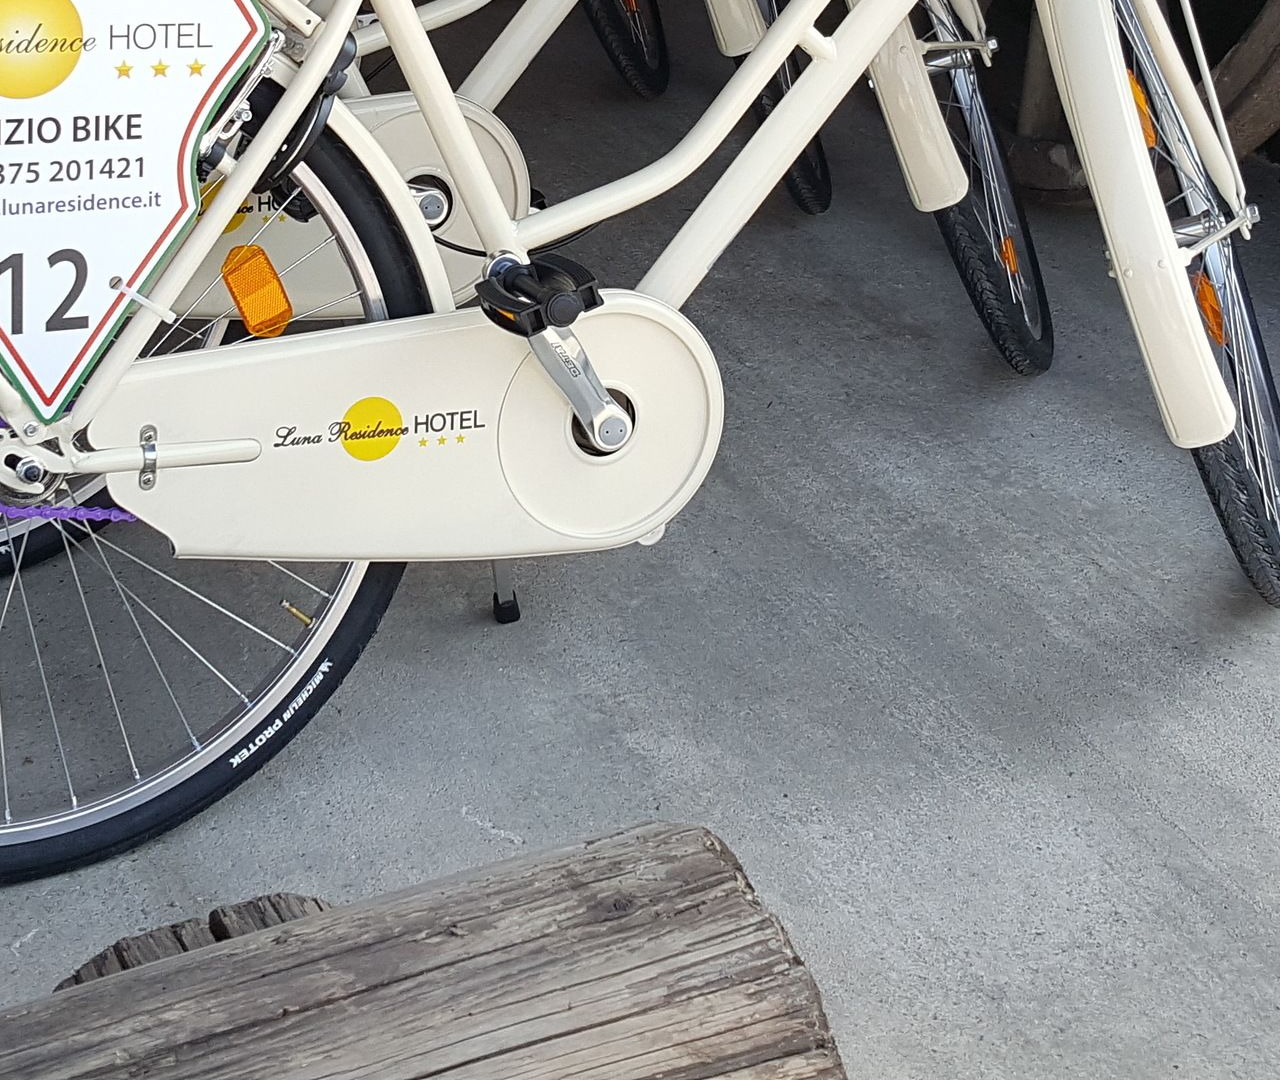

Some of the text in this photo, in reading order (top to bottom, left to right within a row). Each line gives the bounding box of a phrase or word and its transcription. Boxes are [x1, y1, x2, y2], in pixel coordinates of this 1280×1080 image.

[109, 23, 213, 51] HOTEL
[72, 113, 143, 143] BIKE
[49, 156, 144, 183] 201421
[273, 409, 486, 448] Luna Residence HOTEL
[229, 671, 324, 768] MICHELIN PROTEK
